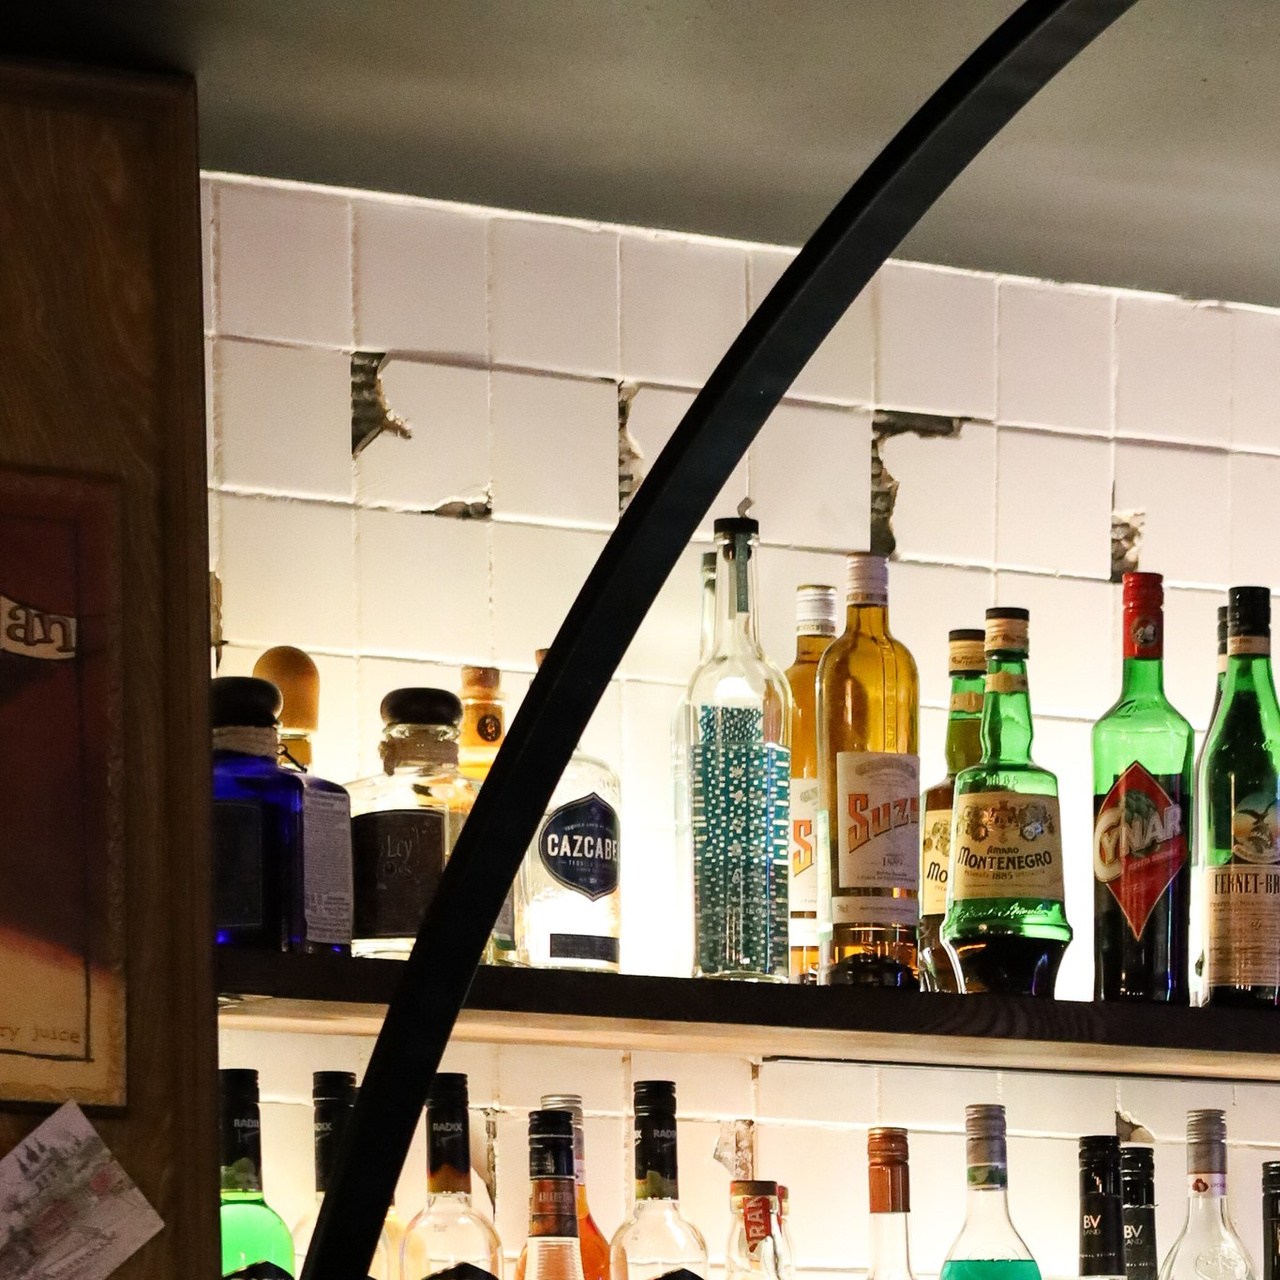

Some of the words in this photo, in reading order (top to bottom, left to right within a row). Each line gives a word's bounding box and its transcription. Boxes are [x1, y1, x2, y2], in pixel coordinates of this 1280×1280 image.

[6, 605, 74, 653] an
[1094, 803, 1182, 883] CYNAR
[957, 847, 1053, 870] MONTENEGRO
[1083, 1214, 1102, 1229] BV
[1124, 1225, 1144, 1239] BV
